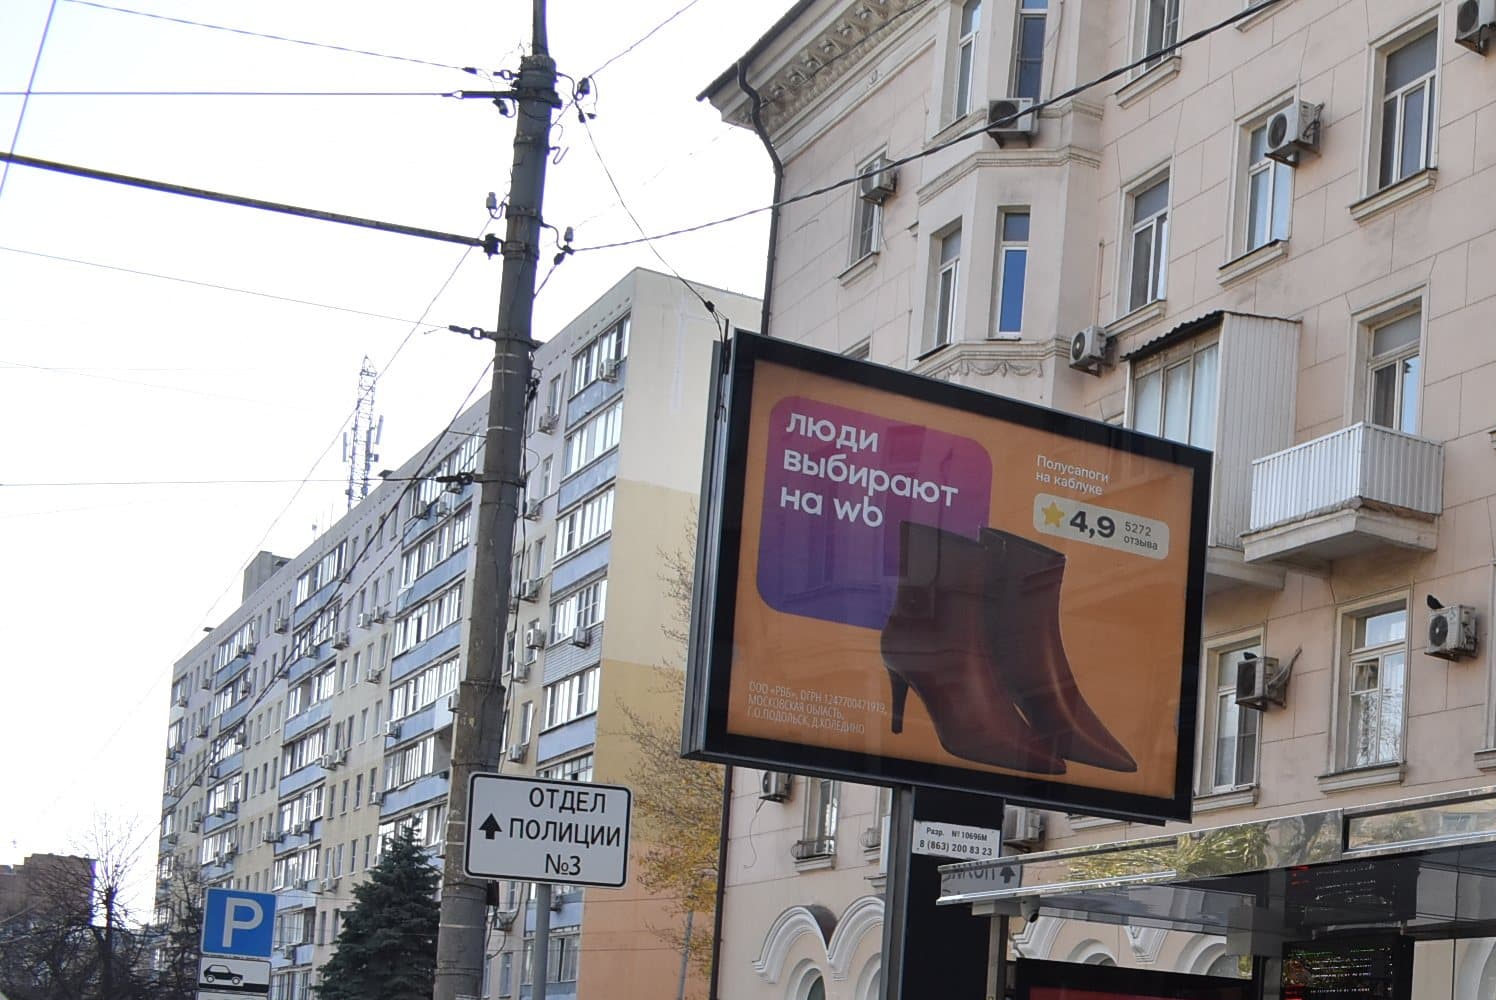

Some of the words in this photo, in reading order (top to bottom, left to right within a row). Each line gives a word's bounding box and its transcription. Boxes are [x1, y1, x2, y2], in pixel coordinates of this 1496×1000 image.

[786, 412, 879, 453] люди
[783, 449, 959, 507] выбирают
[1037, 455, 1109, 483] Полусапоги
[1036, 472, 1051, 483] на
[1054, 476, 1103, 496] каблуке
[780, 486, 823, 516] на
[833, 496, 883, 527] wb
[1069, 510, 1116, 539] 4,9
[1124, 521, 1152, 537] 5272
[1123, 536, 1158, 551] отзыва
[748, 694, 805, 713] МОСКОВСКАЯ
[529, 786, 607, 815] ОТДЕЛ
[509, 817, 621, 849] ПОЛИЦИИ
[919, 840, 925, 848] 8
[927, 840, 950, 852] (863)
[951, 843, 967, 853] 200
[969, 846, 980, 856] 83
[982, 847, 993, 856] 23
[545, 852, 581, 877] №3
[222, 896, 264, 948] P
